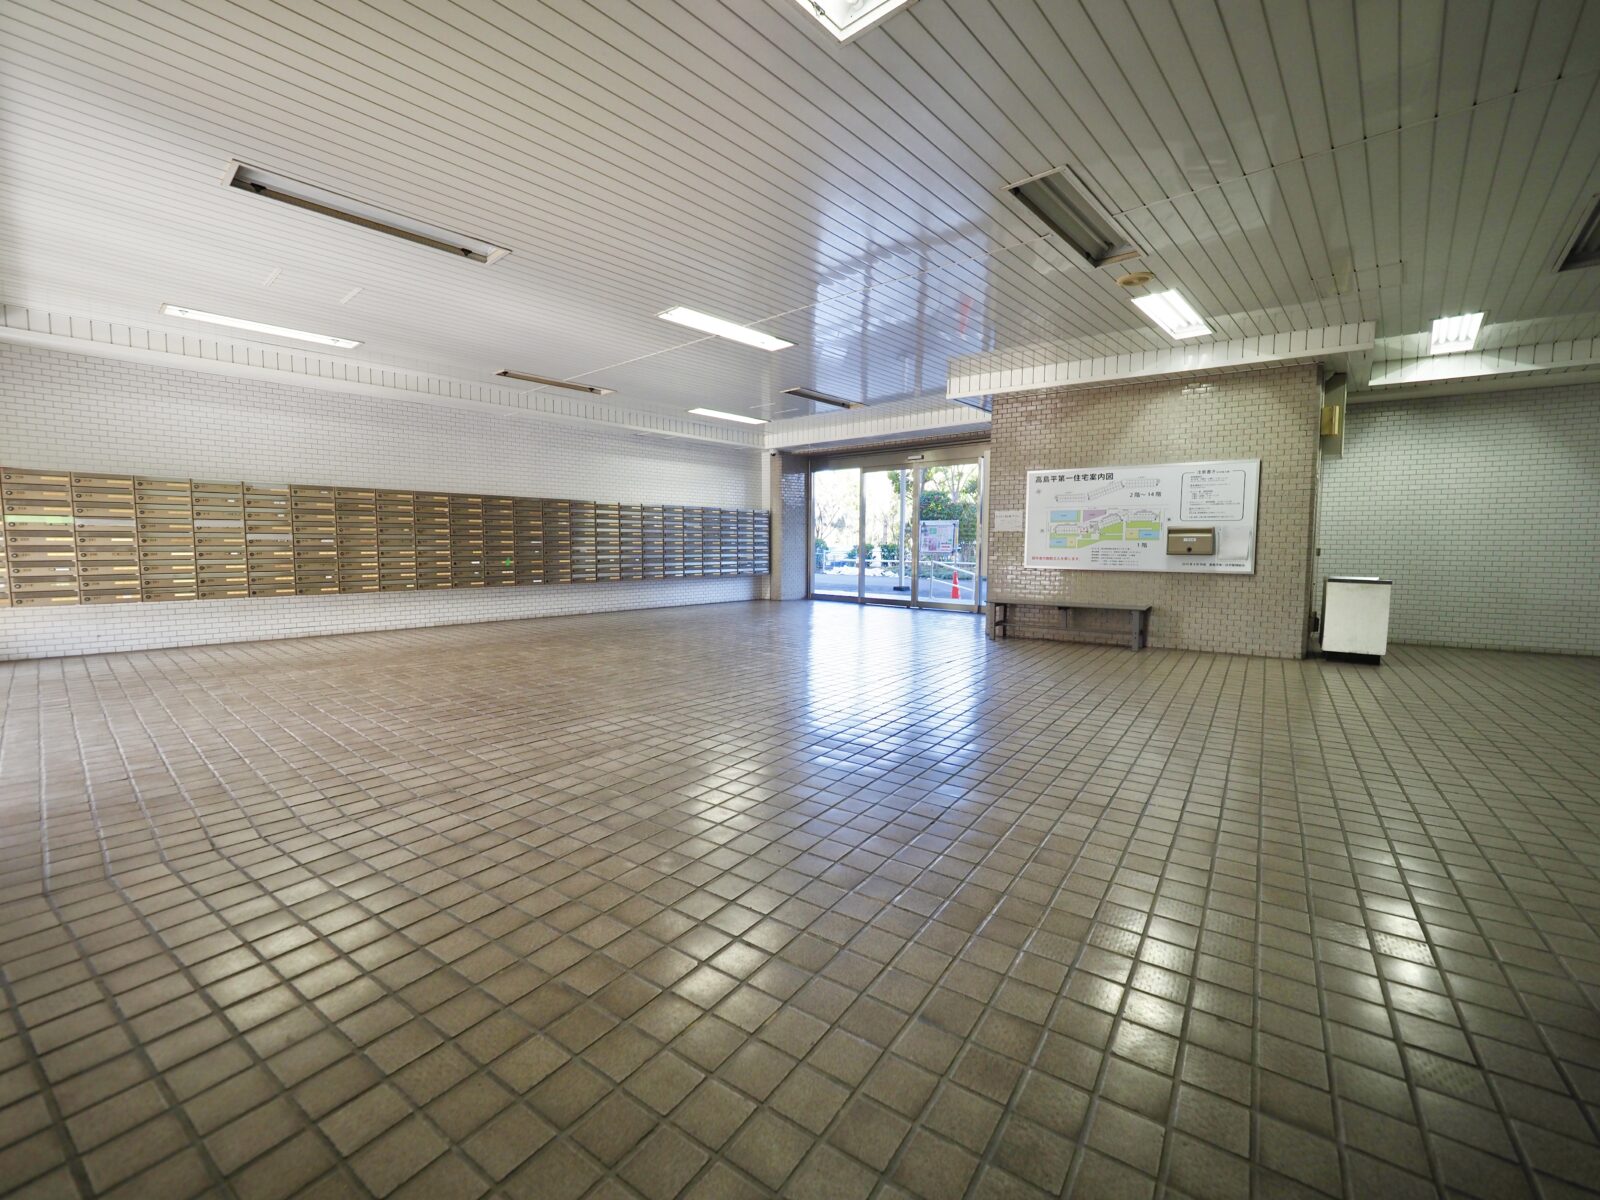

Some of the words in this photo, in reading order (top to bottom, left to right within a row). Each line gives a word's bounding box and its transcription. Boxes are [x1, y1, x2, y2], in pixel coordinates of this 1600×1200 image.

[1035, 472, 1114, 483] 高島平第一住宅案内図
